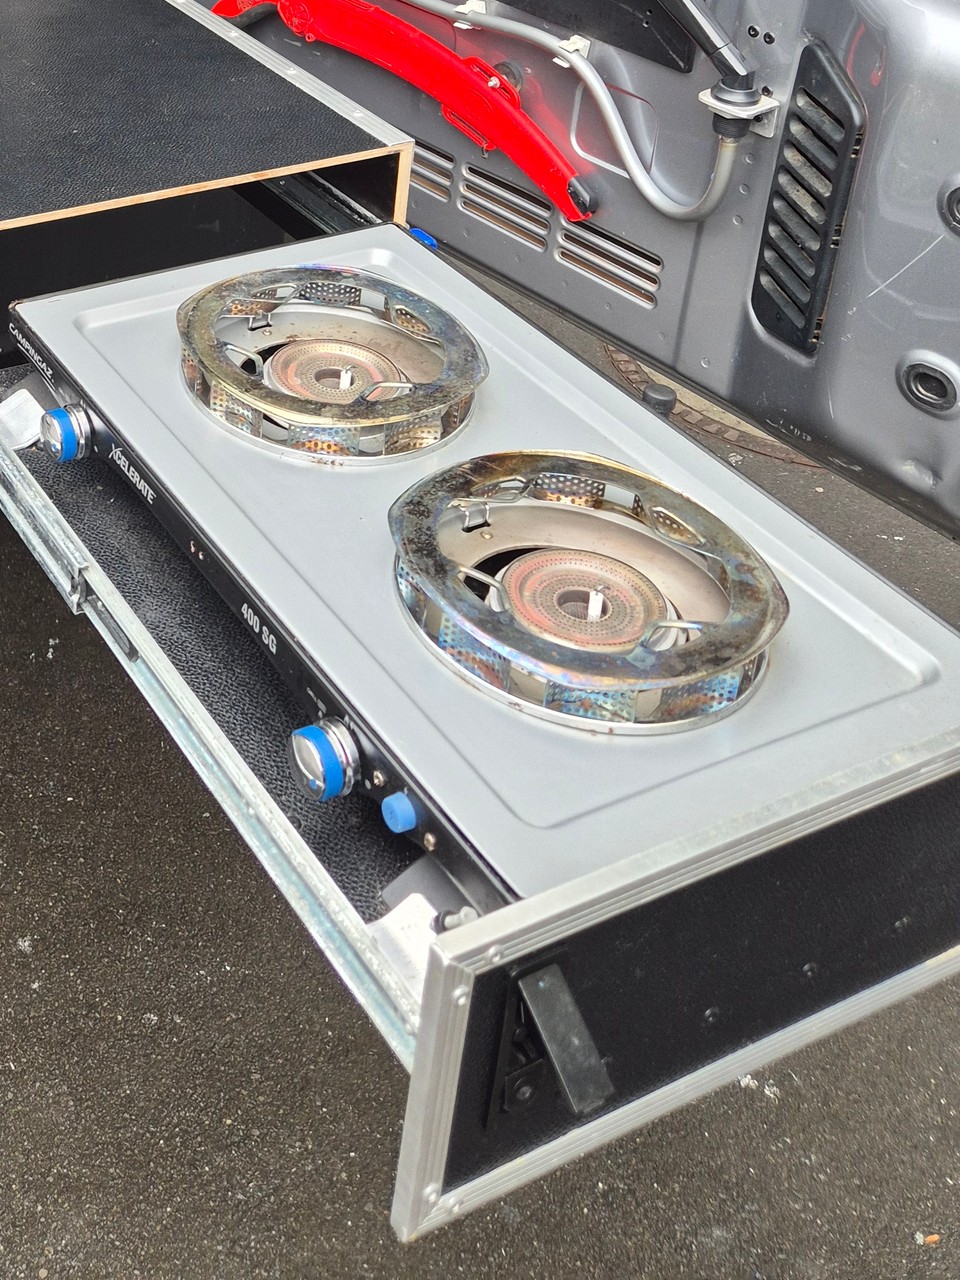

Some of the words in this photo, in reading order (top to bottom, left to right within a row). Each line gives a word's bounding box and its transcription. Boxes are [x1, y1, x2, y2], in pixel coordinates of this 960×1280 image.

[9, 322, 53, 379] CAMPINGAZ
[108, 443, 156, 504] XCELERATE
[241, 602, 260, 633] 400
[262, 625, 277, 654] SG
